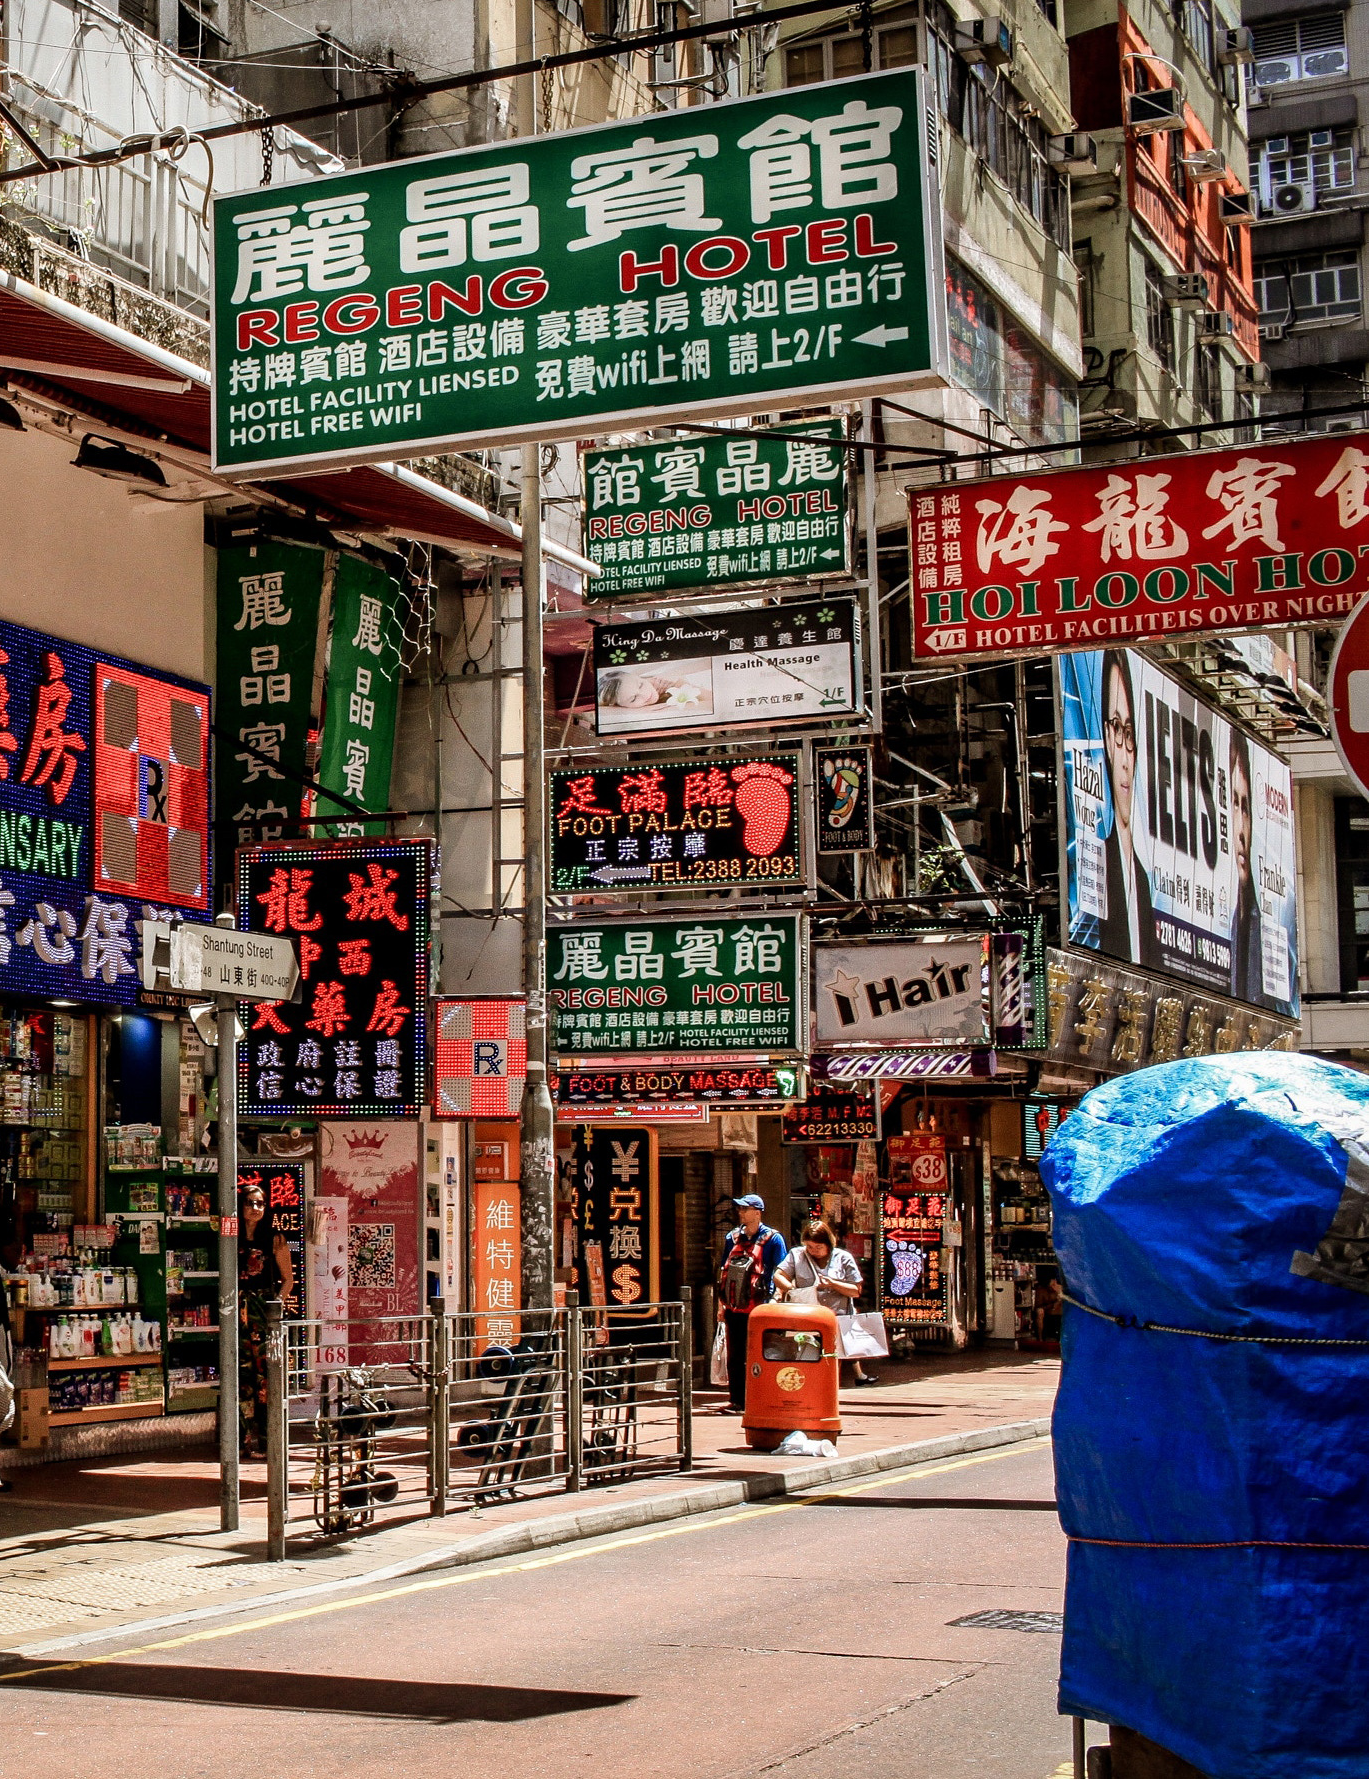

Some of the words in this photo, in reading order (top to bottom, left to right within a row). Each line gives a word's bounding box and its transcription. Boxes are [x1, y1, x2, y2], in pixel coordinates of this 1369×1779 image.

[230, 100, 904, 305] 麗晶賓館
[237, 267, 550, 352] REGENG
[619, 213, 898, 293] HOTEL
[229, 340, 367, 396] 持牌賓館
[379, 317, 525, 375] 酒店設備
[536, 291, 690, 350] 豪華套房
[700, 262, 906, 327] 歡迎自由行
[535, 339, 711, 402] 免費wifi上網
[728, 323, 843, 376] 請上2/F
[230, 396, 304, 423] HOTEL
[310, 380, 412, 412] FACILITY
[419, 365, 519, 396] LIENSED
[230, 421, 304, 447] HOTEL
[311, 412, 363, 436] FREE
[370, 403, 422, 427] WIFI
[589, 505, 712, 540] REGENG
[738, 488, 839, 524] HOTEL
[589, 539, 644, 565] 持牌賓館
[648, 532, 704, 558] 酒店設備
[707, 524, 764, 550] 豪華套房
[767, 516, 839, 545] 歡迎自由行
[916, 496, 937, 590] 酒店設備
[941, 495, 963, 586] 純粹租房
[593, 564, 620, 579] OTEL
[622, 562, 661, 576] FACILITY
[664, 557, 702, 573] LIENSED
[590, 579, 620, 593] HOTEL
[622, 577, 643, 589] FREE
[646, 575, 665, 588] WIFI
[922, 581, 1042, 627] HOI
[1054, 559, 1237, 614] LOON
[641, 629, 663, 644] Da
[665, 627, 728, 641] Massage
[729, 627, 842, 651] 慶達養生館
[933, 631, 966, 649] 1/F
[975, 624, 1059, 648] HOTEL
[1064, 608, 1202, 639] FACILITEIS
[1209, 602, 1280, 625] OVER
[725, 659, 763, 671] Health
[767, 653, 820, 667] Massage
[734, 692, 804, 708] 正宗穴位按摩
[824, 687, 845, 699] 1/F
[1072, 747, 1104, 802] Hazal
[1145, 690, 1219, 871] IELTS
[556, 767, 734, 819] 足滿臨
[558, 815, 622, 837] FOOT
[629, 808, 733, 833] PALACE
[1074, 793, 1096, 833] Wong
[585, 832, 706, 862] 正宗按摩
[825, 831, 842, 843] FOOT
[847, 830, 863, 842] BODY
[556, 865, 591, 886] 2/F
[746, 856, 795, 877] 2093
[1258, 855, 1285, 898] Frankie
[256, 864, 409, 932] 龍城
[203, 934, 244, 958] Shantung
[247, 941, 274, 960] Street
[554, 923, 786, 982] 麗晶賓館
[220, 964, 257, 988] 山東街
[865, 956, 973, 1018] Hair
[550, 985, 668, 1009] REGENG
[692, 981, 790, 1006] HOTEL
[605, 1011, 659, 1027] 酒店設備
[662, 1009, 717, 1026] 豪華套房
[720, 1008, 790, 1025] 歡迎自由行
[680, 1028, 708, 1037] HOTEL
[710, 1027, 749, 1037] FACILITY
[751, 1026, 789, 1036] LIENSED
[679, 1038, 723, 1047] HOTEL
[725, 1037, 756, 1046] FREE
[759, 1036, 788, 1045] WIFI
[569, 1077, 617, 1093] FOOT
[620, 1077, 631, 1091] &
[635, 1075, 685, 1091] BODY
[689, 1072, 778, 1090] MASSAGE
[807, 1122, 874, 1136] 62213330
[387, 1293, 404, 1312] BL
[884, 1296, 904, 1306] Foot
[904, 1296, 943, 1309] Massage
[315, 1347, 347, 1364] 168
